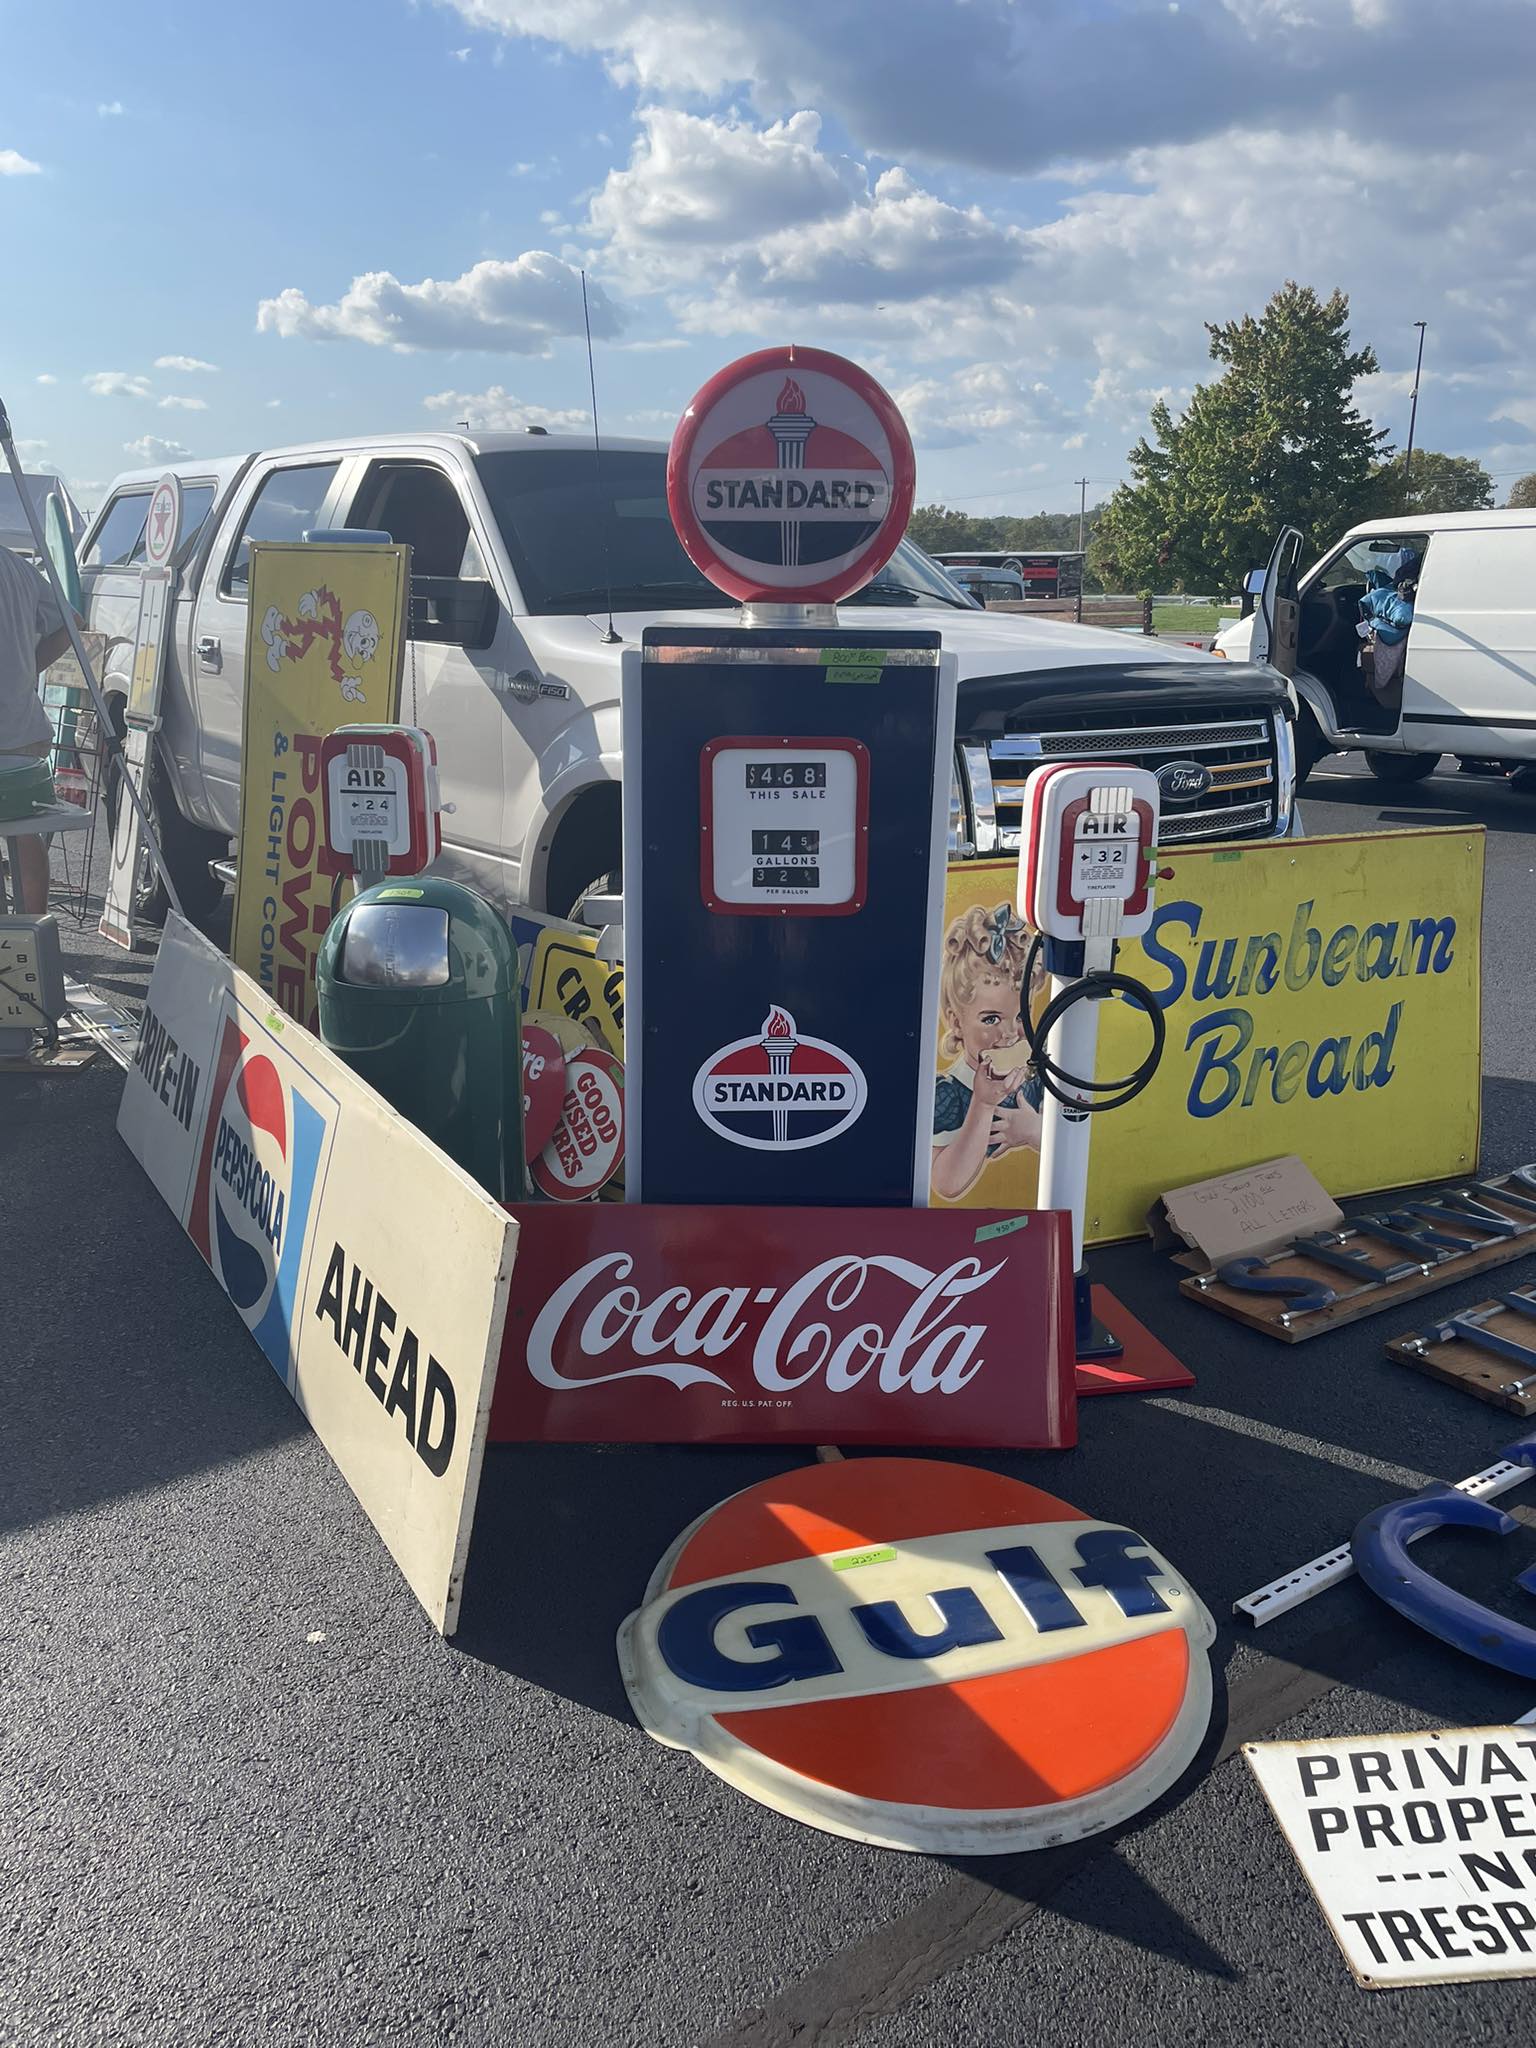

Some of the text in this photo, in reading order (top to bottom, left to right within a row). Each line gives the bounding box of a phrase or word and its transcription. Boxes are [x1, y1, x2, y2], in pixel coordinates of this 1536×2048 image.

[706, 479, 875, 509] STANDARD
[540, 685, 565, 698] F150
[273, 731, 289, 757] &
[347, 769, 386, 788] AIR
[366, 800, 389, 810] 24
[750, 790, 826, 800] THIS SALE
[1171, 769, 1204, 791] Ford
[265, 770, 288, 886] LIGHT
[1082, 813, 1129, 835] AIR
[277, 734, 323, 1032] POWE
[756, 856, 817, 866] GALLONS
[1098, 850, 1122, 863] 32
[1122, 898, 1457, 1011] Sunbeam
[134, 1004, 201, 1132] DRIVE-IN
[1184, 1000, 1404, 1119] Bread
[577, 1072, 618, 1144] GOOD
[714, 1082, 846, 1103] STANDARD
[551, 1117, 583, 1180] IRES
[562, 1089, 598, 1157] USED
[214, 1115, 286, 1257] PEPSI-COLA
[1239, 1218, 1268, 1234] ALL
[525, 1251, 1009, 1395] Coca-Cola
[315, 1241, 457, 1478] AHEAD
[657, 1529, 1173, 1692] Gulf
[1309, 1798, 1536, 1852] PROPE
